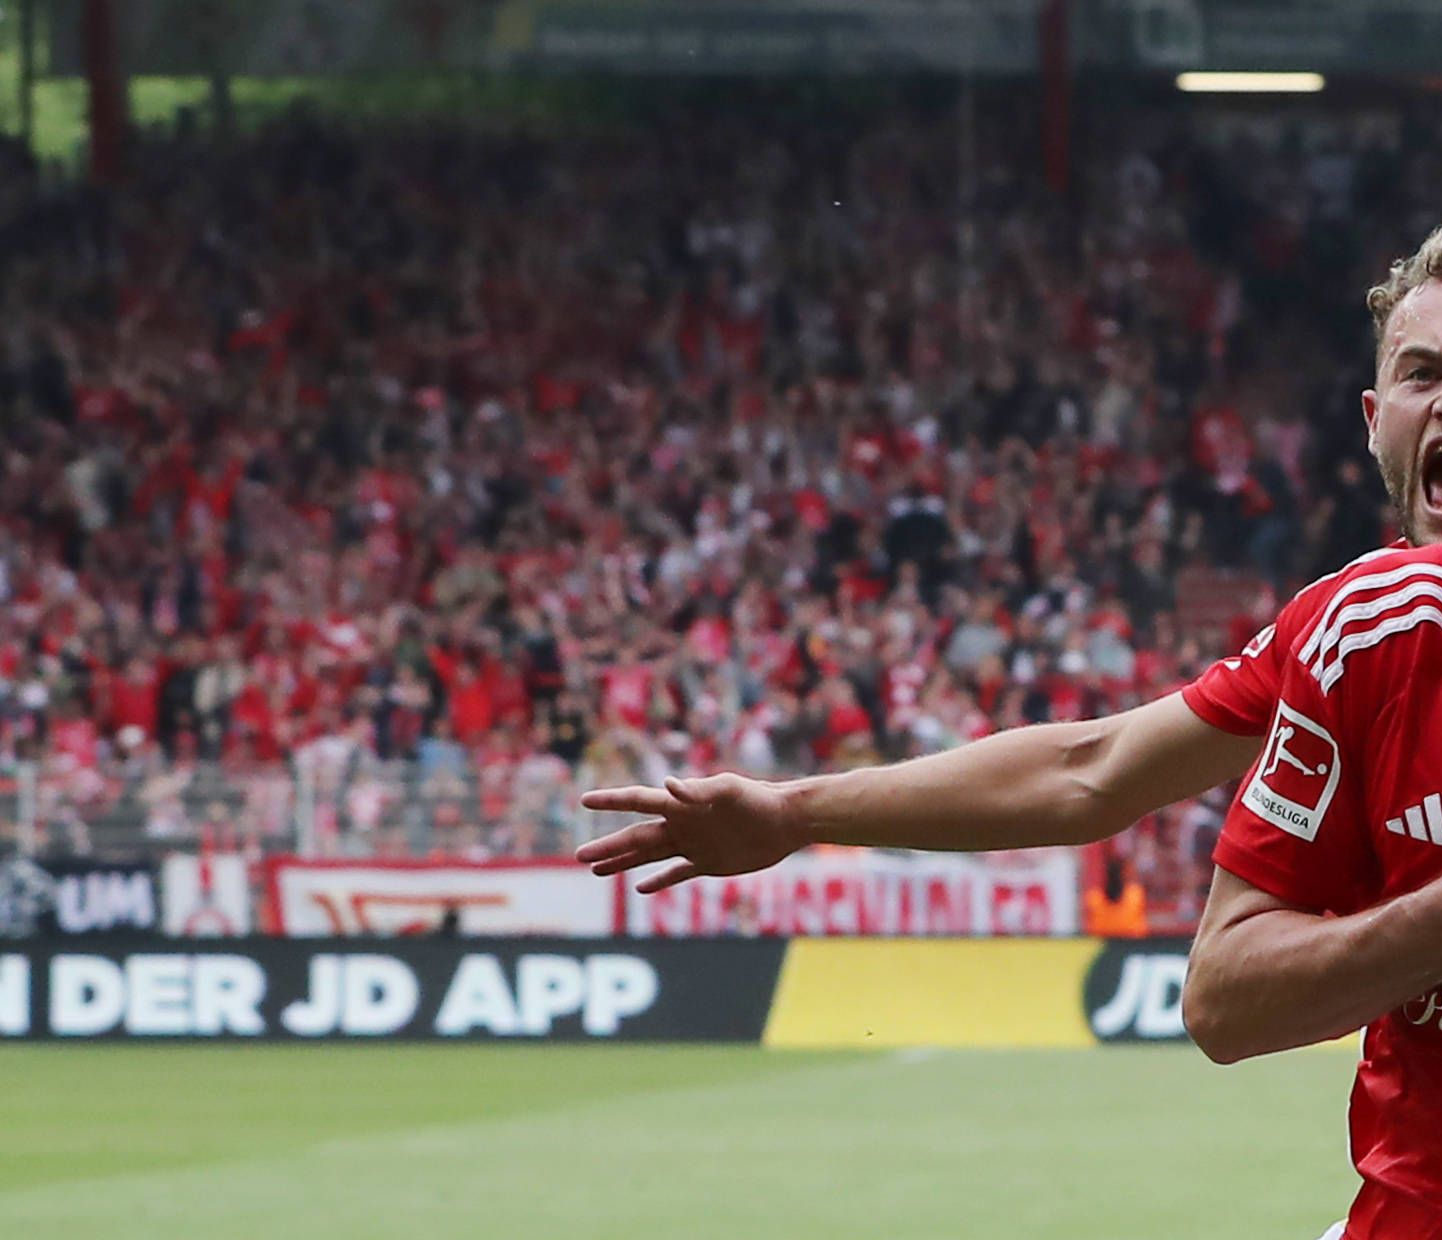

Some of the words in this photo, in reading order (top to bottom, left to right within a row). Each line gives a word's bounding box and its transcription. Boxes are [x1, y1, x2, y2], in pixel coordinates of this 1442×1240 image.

[49, 952, 269, 1036] DER
[281, 952, 419, 1036] JD
[434, 952, 659, 1036] APP
[1093, 953, 1190, 1037] JD
